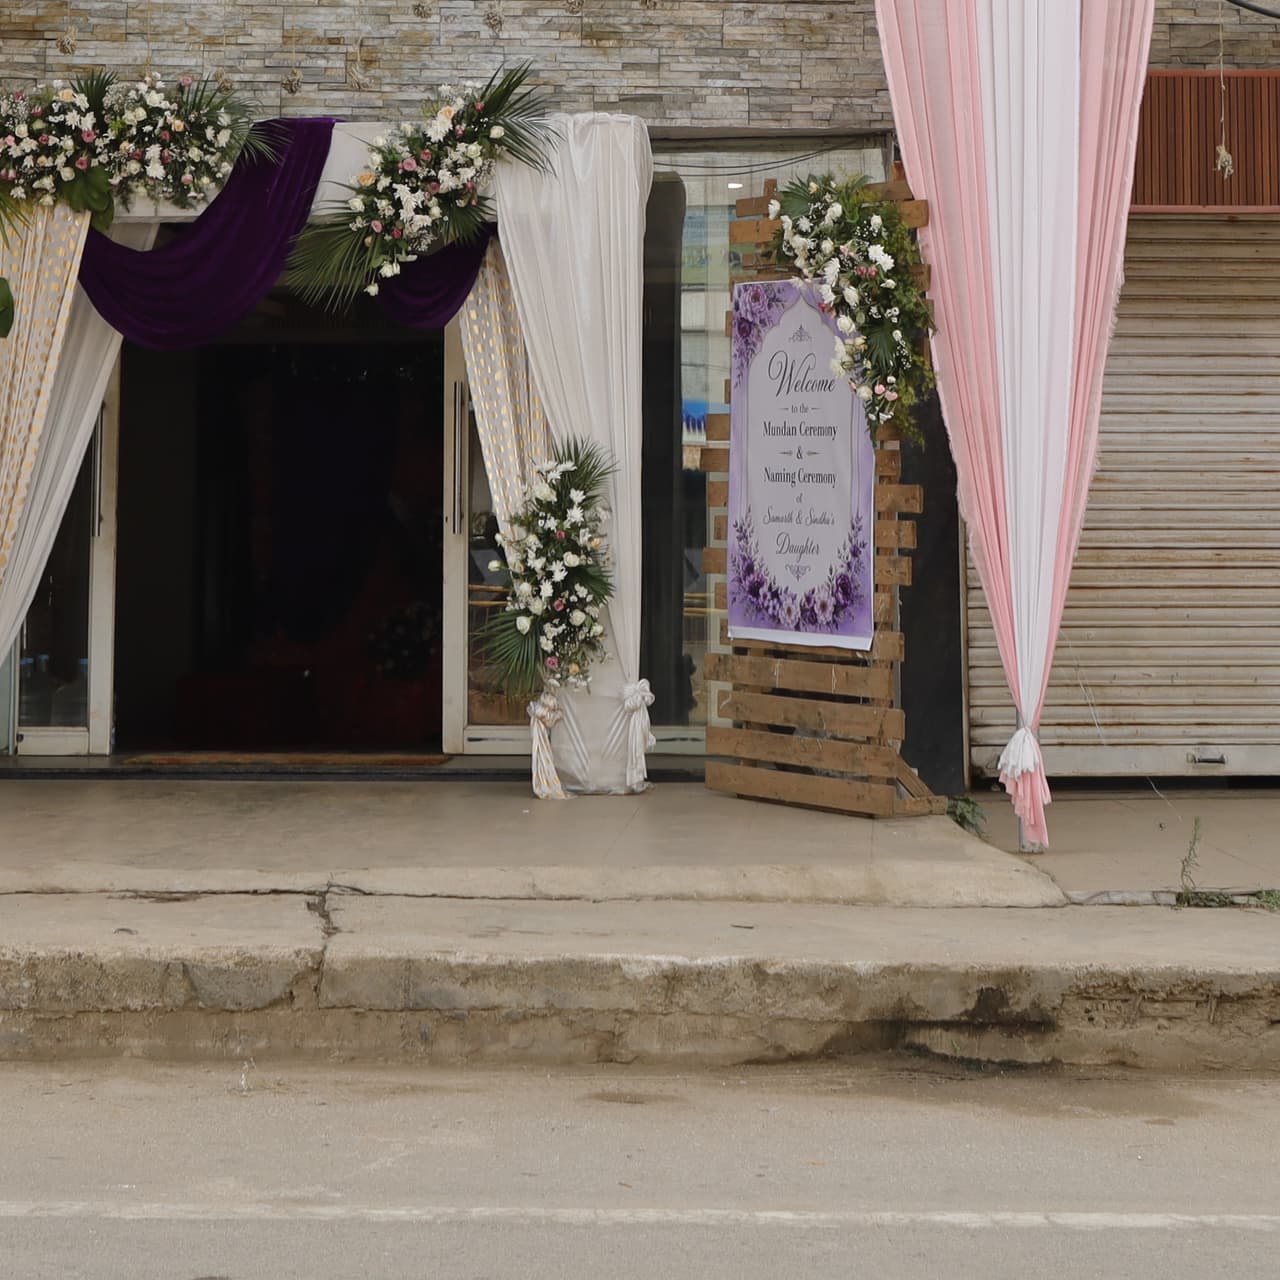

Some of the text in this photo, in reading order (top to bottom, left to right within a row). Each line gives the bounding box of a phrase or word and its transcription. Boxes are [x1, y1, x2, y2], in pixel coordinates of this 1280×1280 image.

[768, 350, 835, 397] Welcome
[791, 403, 808, 413] to the
[763, 421, 838, 441] Mundan Ceremony
[796, 446, 803, 460] &
[764, 467, 836, 488] Naming Ceremony
[795, 510, 802, 524] &
[776, 531, 820, 562] Daughter
